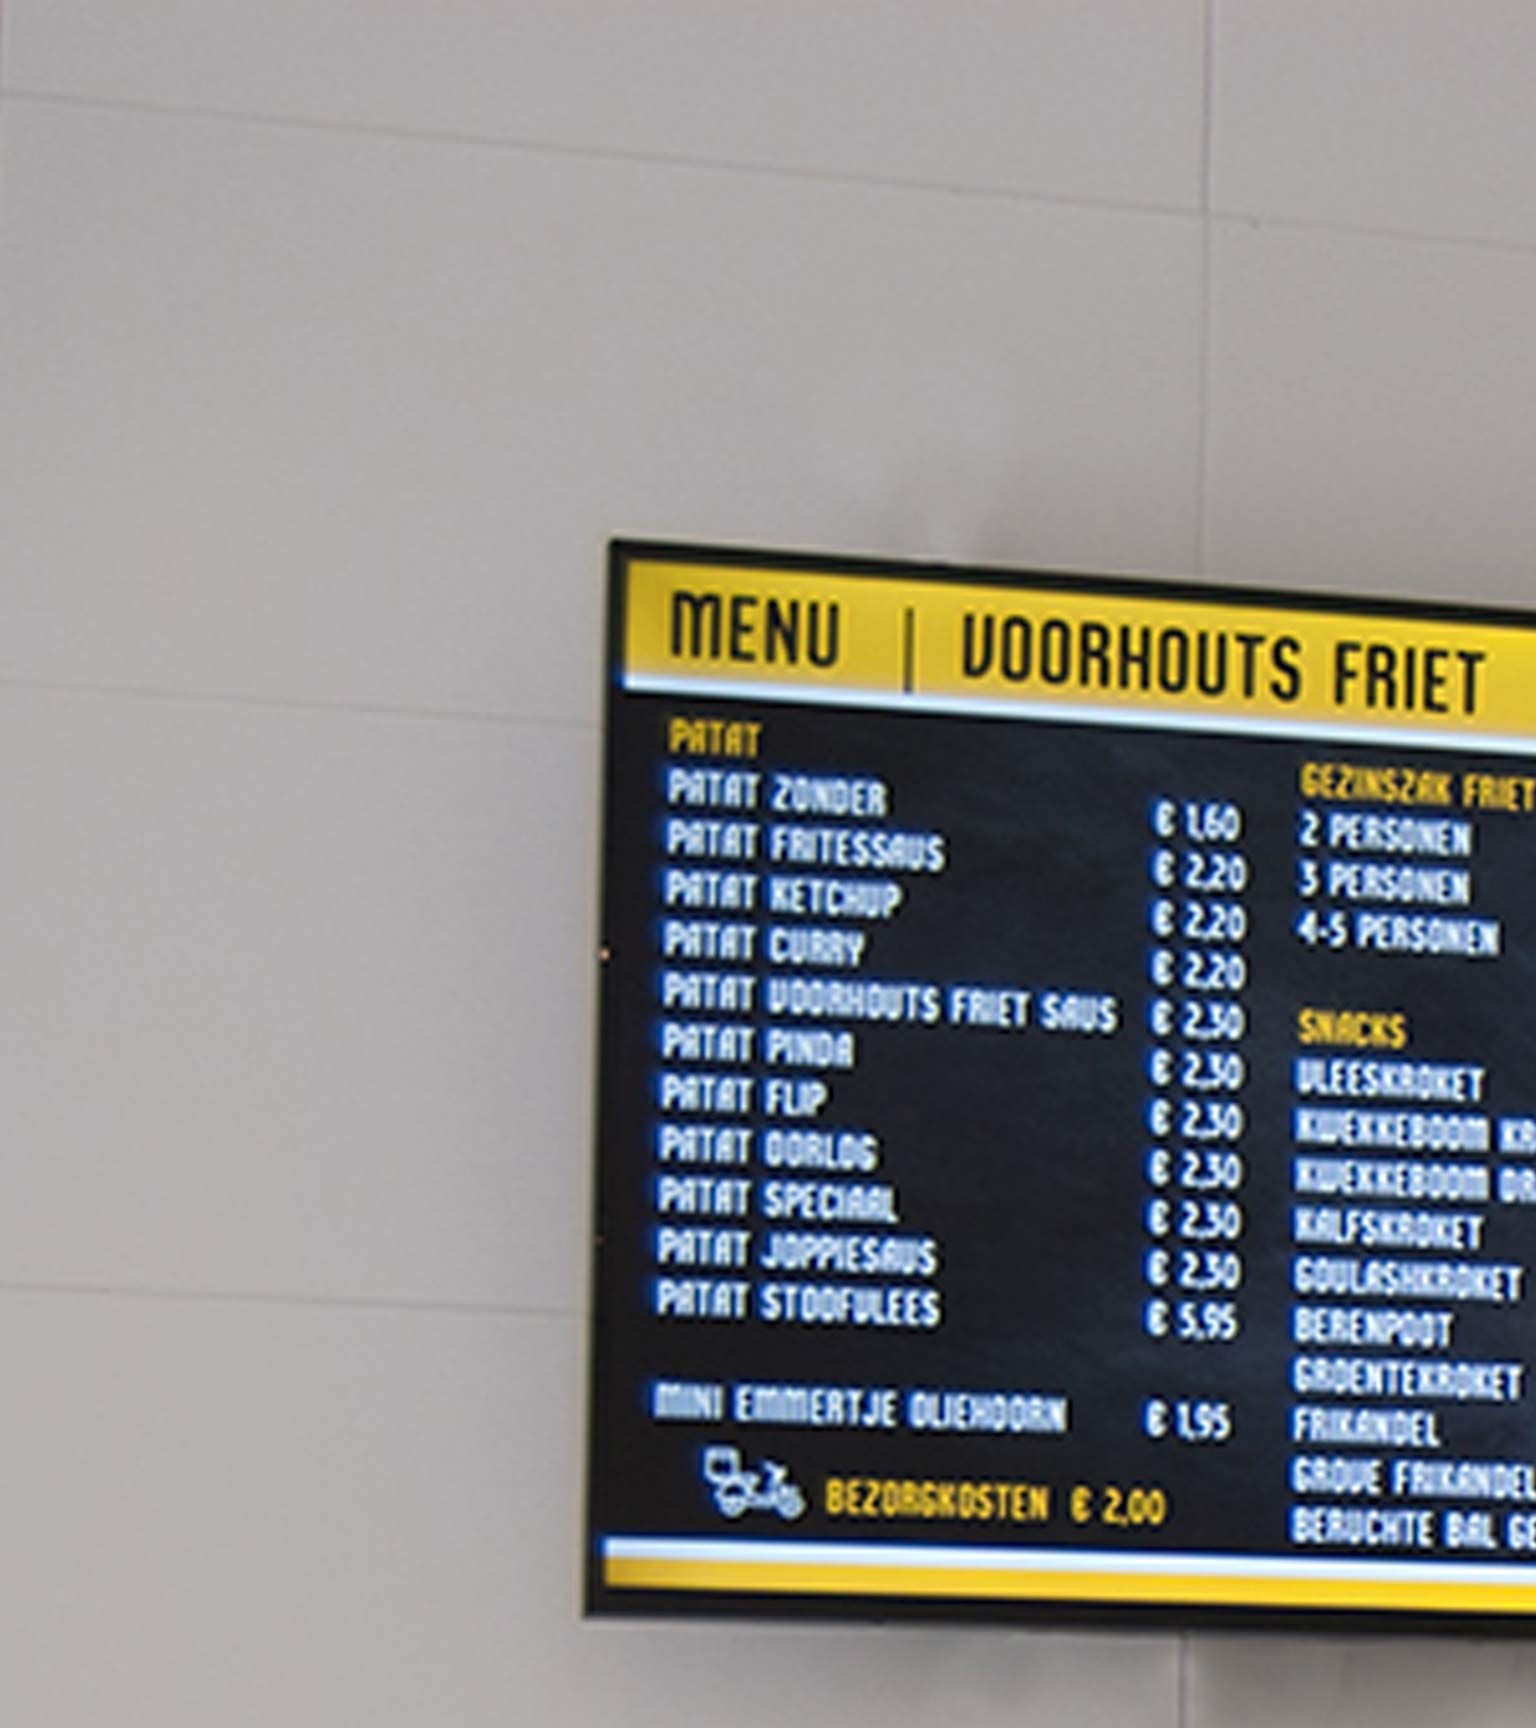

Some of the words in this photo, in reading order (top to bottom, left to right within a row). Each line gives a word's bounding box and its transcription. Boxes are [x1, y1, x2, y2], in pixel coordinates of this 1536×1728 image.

[669, 588, 840, 669] MENU
[960, 611, 1302, 704] VOORHOUTS
[1332, 639, 1486, 716] FRIET
[667, 715, 762, 757] PATAT
[667, 766, 761, 809] PATAT
[771, 773, 888, 818] ZONDER
[666, 817, 760, 859] PATAT
[769, 823, 946, 872] FRITESSAUS
[665, 867, 759, 910] PATAT
[769, 875, 904, 919] KETCHUP
[663, 919, 758, 961] PATAT
[767, 924, 866, 967] CURRY
[662, 970, 757, 1012] PATAT
[767, 976, 941, 1024] VOORHOUTS
[950, 985, 1031, 1028] FRIET
[1040, 991, 1119, 1034] SAUS
[661, 1020, 756, 1062] PATAT
[765, 1026, 855, 1068] PINDA
[660, 1071, 755, 1114] PATAT
[764, 1076, 829, 1118] FLIP
[659, 1123, 754, 1164] PATAT
[764, 1128, 879, 1172] OORLOG
[657, 1174, 752, 1216] PATAT
[763, 1179, 899, 1224] SPECIAAL
[657, 1226, 752, 1267] PATAT
[760, 1231, 939, 1277] JOPPIESAUS
[656, 1277, 750, 1318] PATAT
[760, 1281, 942, 1328] STOOFVLEES
[823, 1476, 1049, 1521] BEZORGKOSTEN
[1101, 1485, 1167, 1527] 2,00
